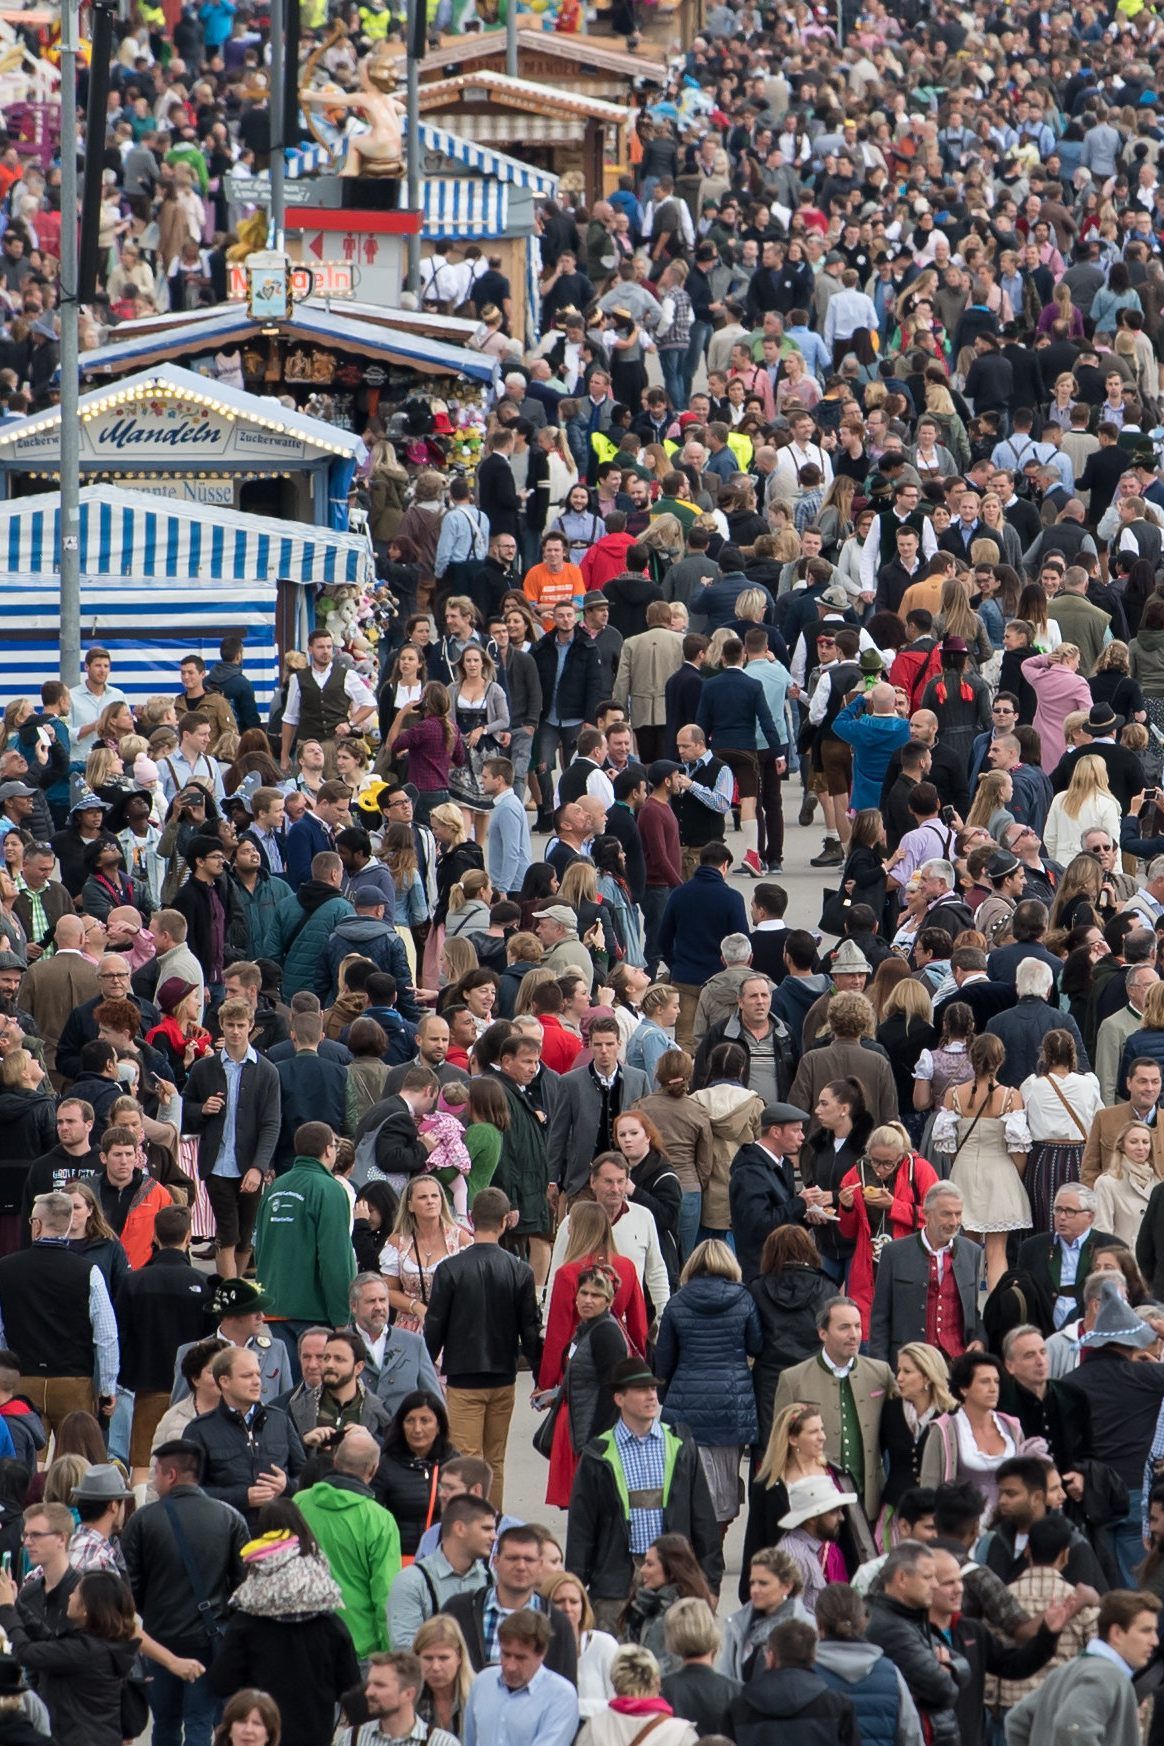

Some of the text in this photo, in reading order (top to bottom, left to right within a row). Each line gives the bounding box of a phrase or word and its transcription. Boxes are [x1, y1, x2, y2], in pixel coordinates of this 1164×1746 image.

[230, 266, 350, 290] Mdeln
[17, 436, 60, 449] Zuckerw
[98, 419, 222, 447] Mandeln
[240, 431, 303, 449] Zuckerwatte
[183, 480, 232, 503] Nüsse
